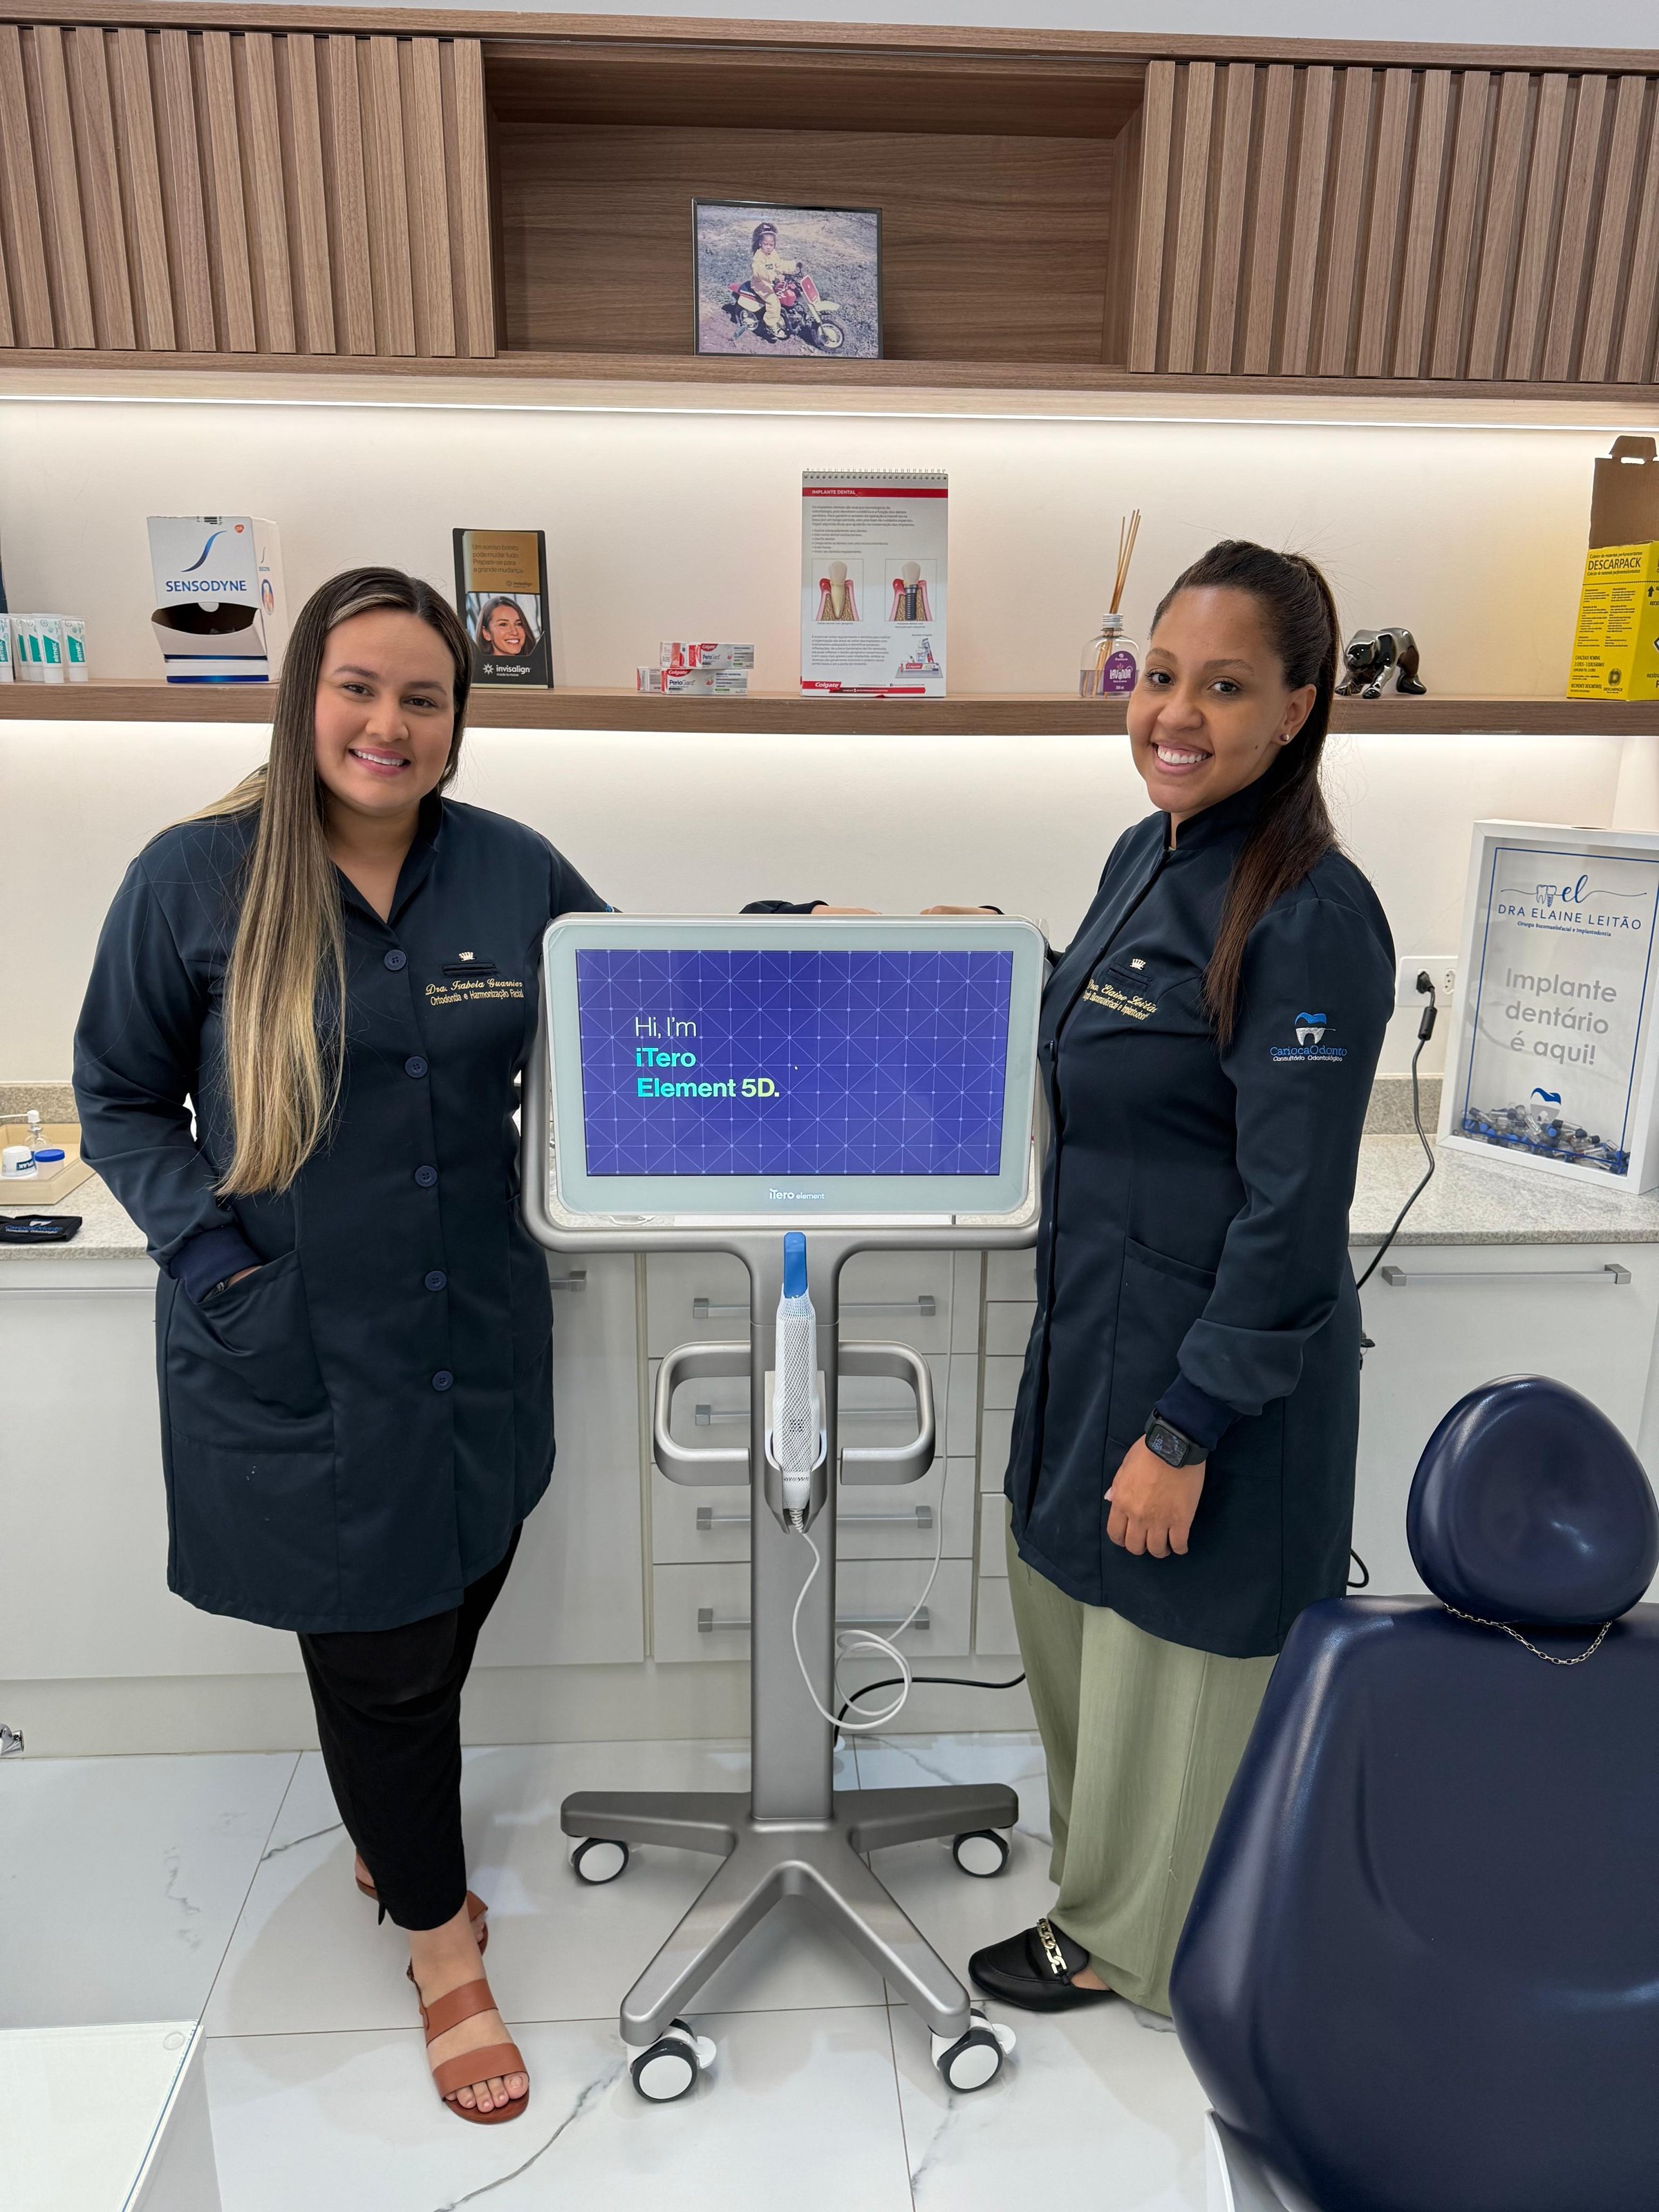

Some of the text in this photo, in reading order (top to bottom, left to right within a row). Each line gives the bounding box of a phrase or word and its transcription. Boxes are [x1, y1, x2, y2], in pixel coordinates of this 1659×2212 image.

[1588, 557, 1642, 570] DESCARPACK
[166, 581, 247, 592] SENSODYNE
[496, 665, 530, 675] invisalign
[1498, 904, 1641, 929] DRA ELAINE LEITÃO
[1535, 923, 1572, 932] Bucomaxilofacial
[1576, 928, 1611, 937] Implantodontia
[426, 983, 448, 995] Dra.
[451, 980, 485, 991] Isabela
[1101, 984, 1127, 1001] Elaine
[1506, 968, 1617, 1002] Implante
[431, 993, 462, 1006] Ortodontia
[469, 989, 509, 1000] Harmonização
[509, 989, 524, 997] Facial
[1506, 1001, 1609, 1034] dentário
[635, 1017, 696, 1038] Hi, I’m
[1270, 1045, 1347, 1056] CariocaOdonto
[1510, 1030, 1595, 1065] é aqui!
[636, 1047, 696, 1067] iTero
[637, 1078, 779, 1098] Element 5D.
[769, 1188, 795, 1199] iTero
